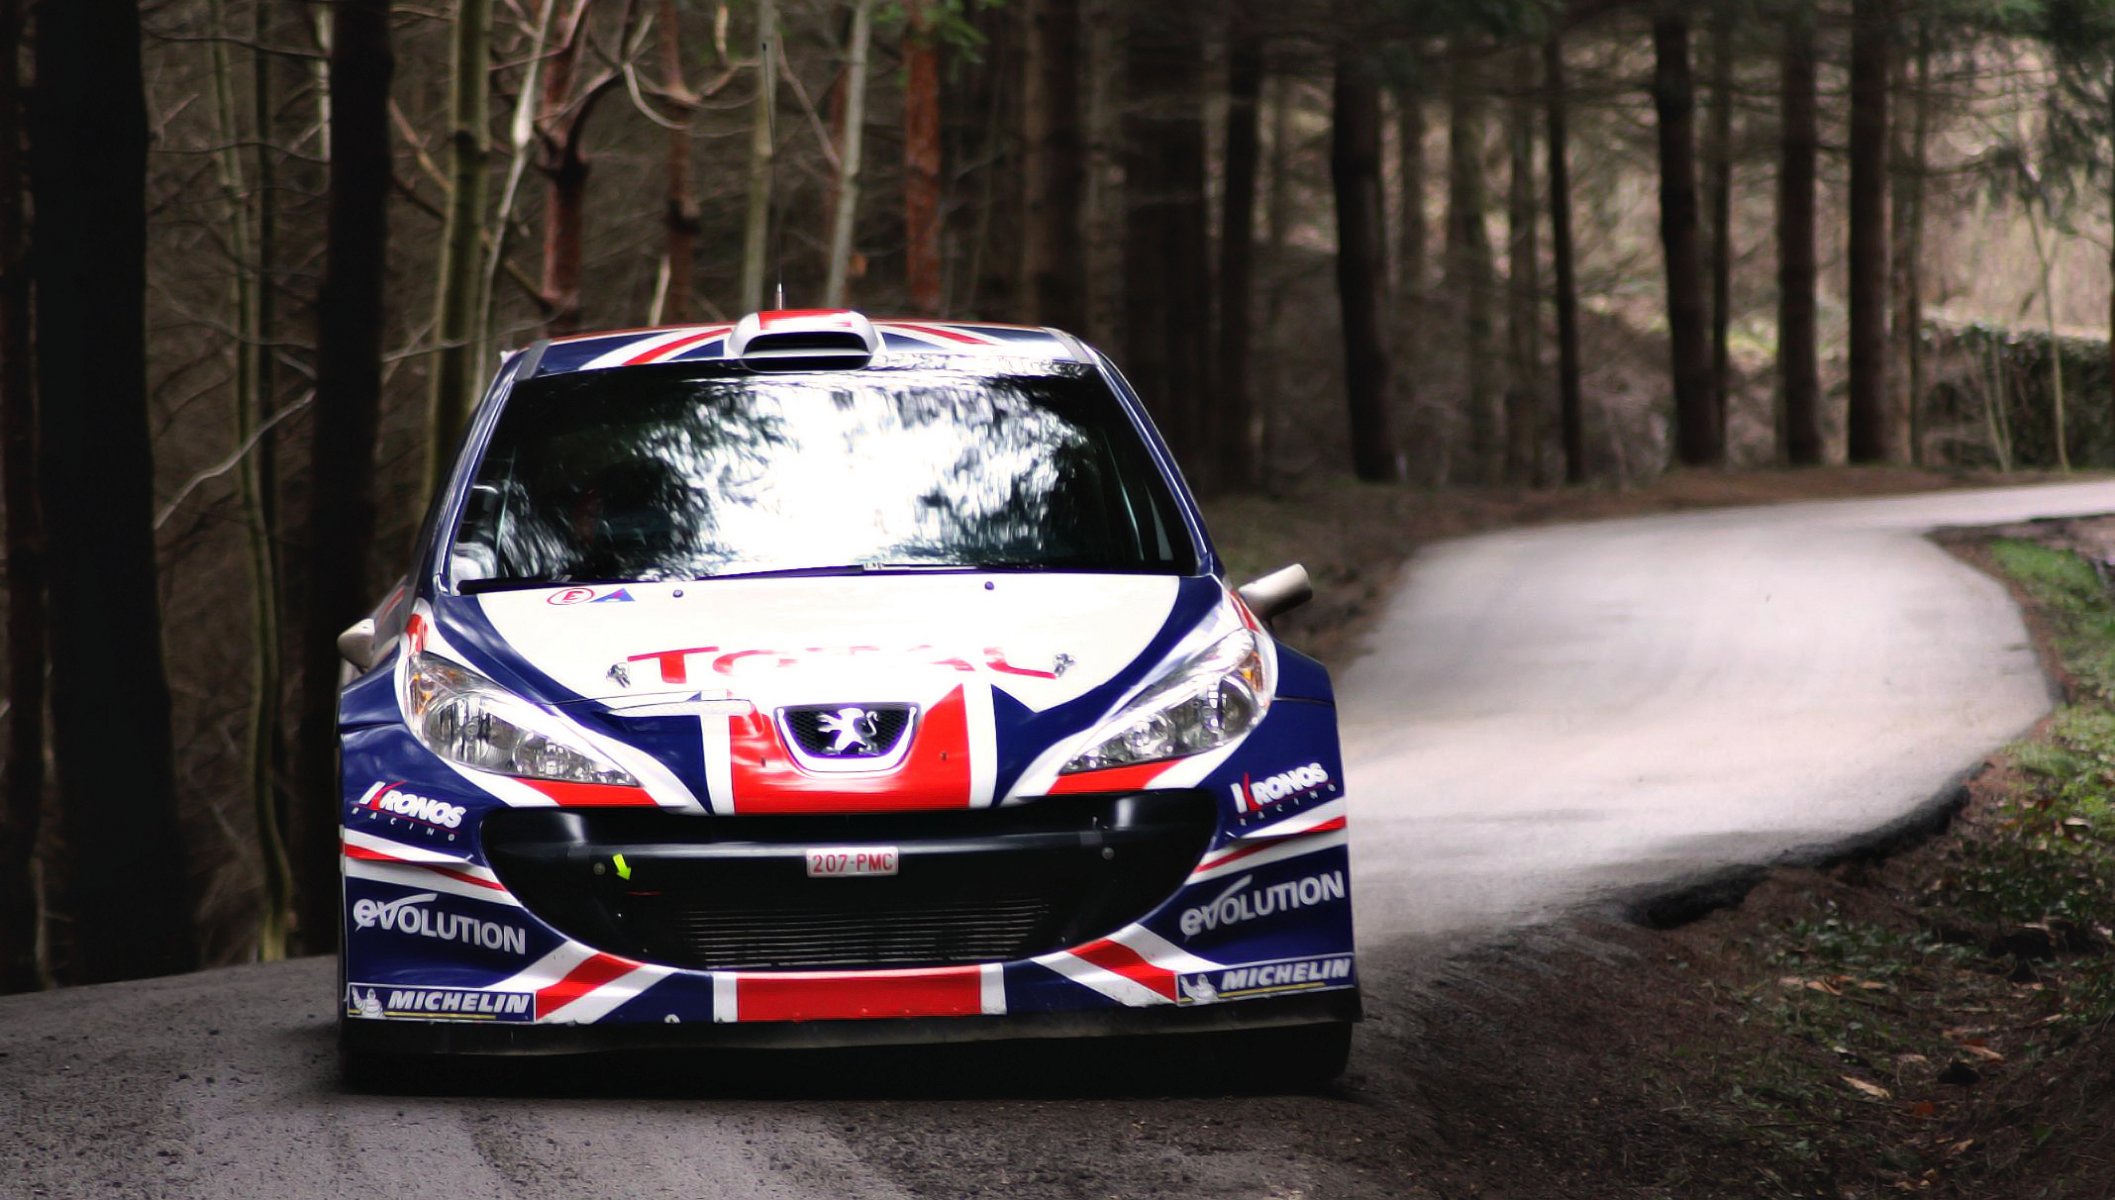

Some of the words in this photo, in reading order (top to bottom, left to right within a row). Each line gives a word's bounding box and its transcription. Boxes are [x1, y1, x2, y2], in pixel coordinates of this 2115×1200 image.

[627, 645, 1057, 684] TOL
[359, 779, 467, 828] KRONOS
[1230, 762, 1328, 814] KRONOS
[813, 853, 893, 873] 207-PMC
[1221, 958, 1351, 991] MICHELIN
[387, 990, 530, 1014] MICHELIN
